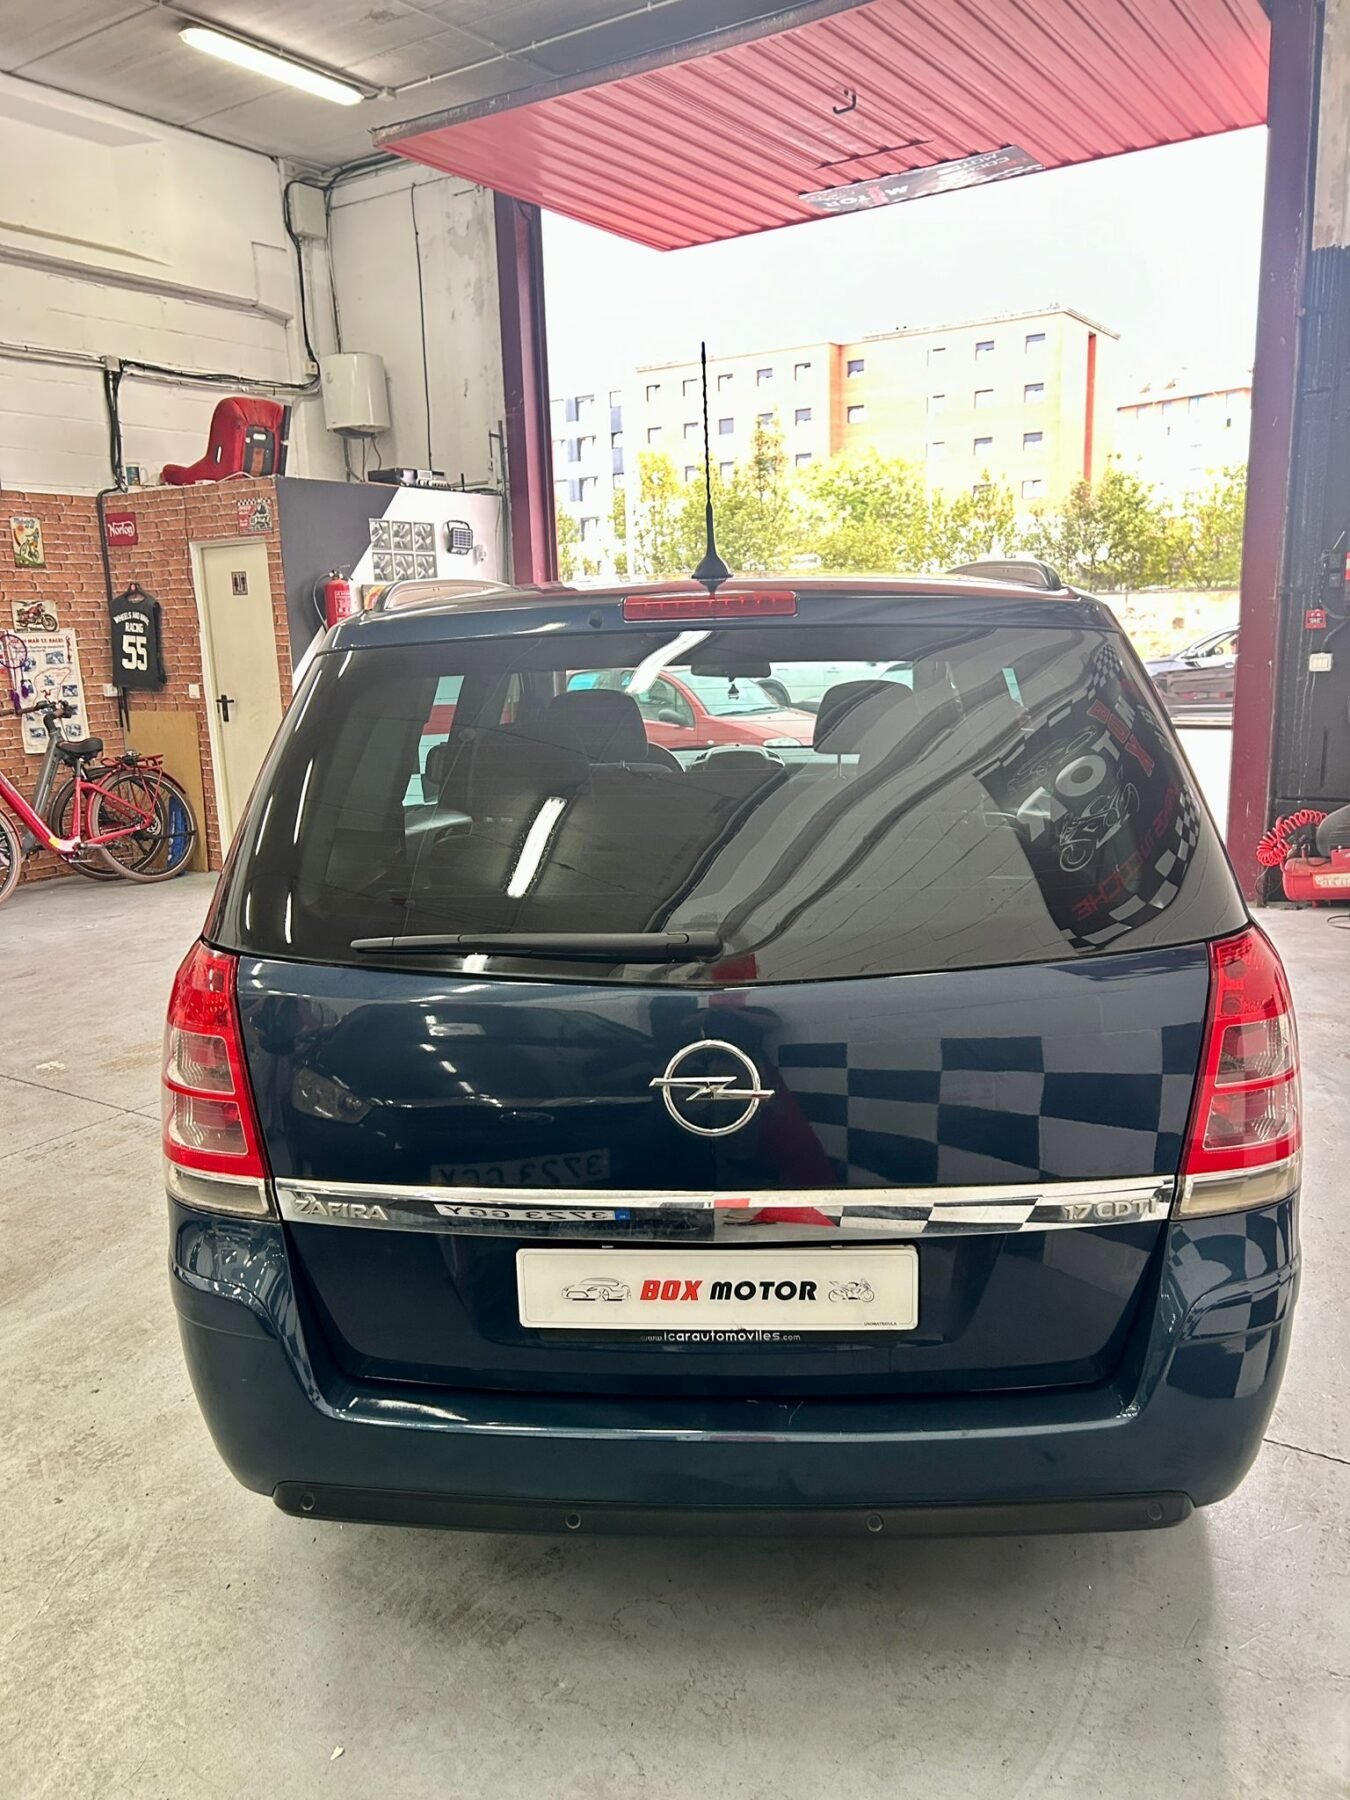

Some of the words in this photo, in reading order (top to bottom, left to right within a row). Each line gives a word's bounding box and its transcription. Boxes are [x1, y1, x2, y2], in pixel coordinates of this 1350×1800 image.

[108, 520, 135, 537] Norton
[121, 635, 148, 671] 55
[294, 1198, 389, 1220] ZAFIRA
[640, 1280, 703, 1300] BOX
[710, 1280, 818, 1301] MOTOR
